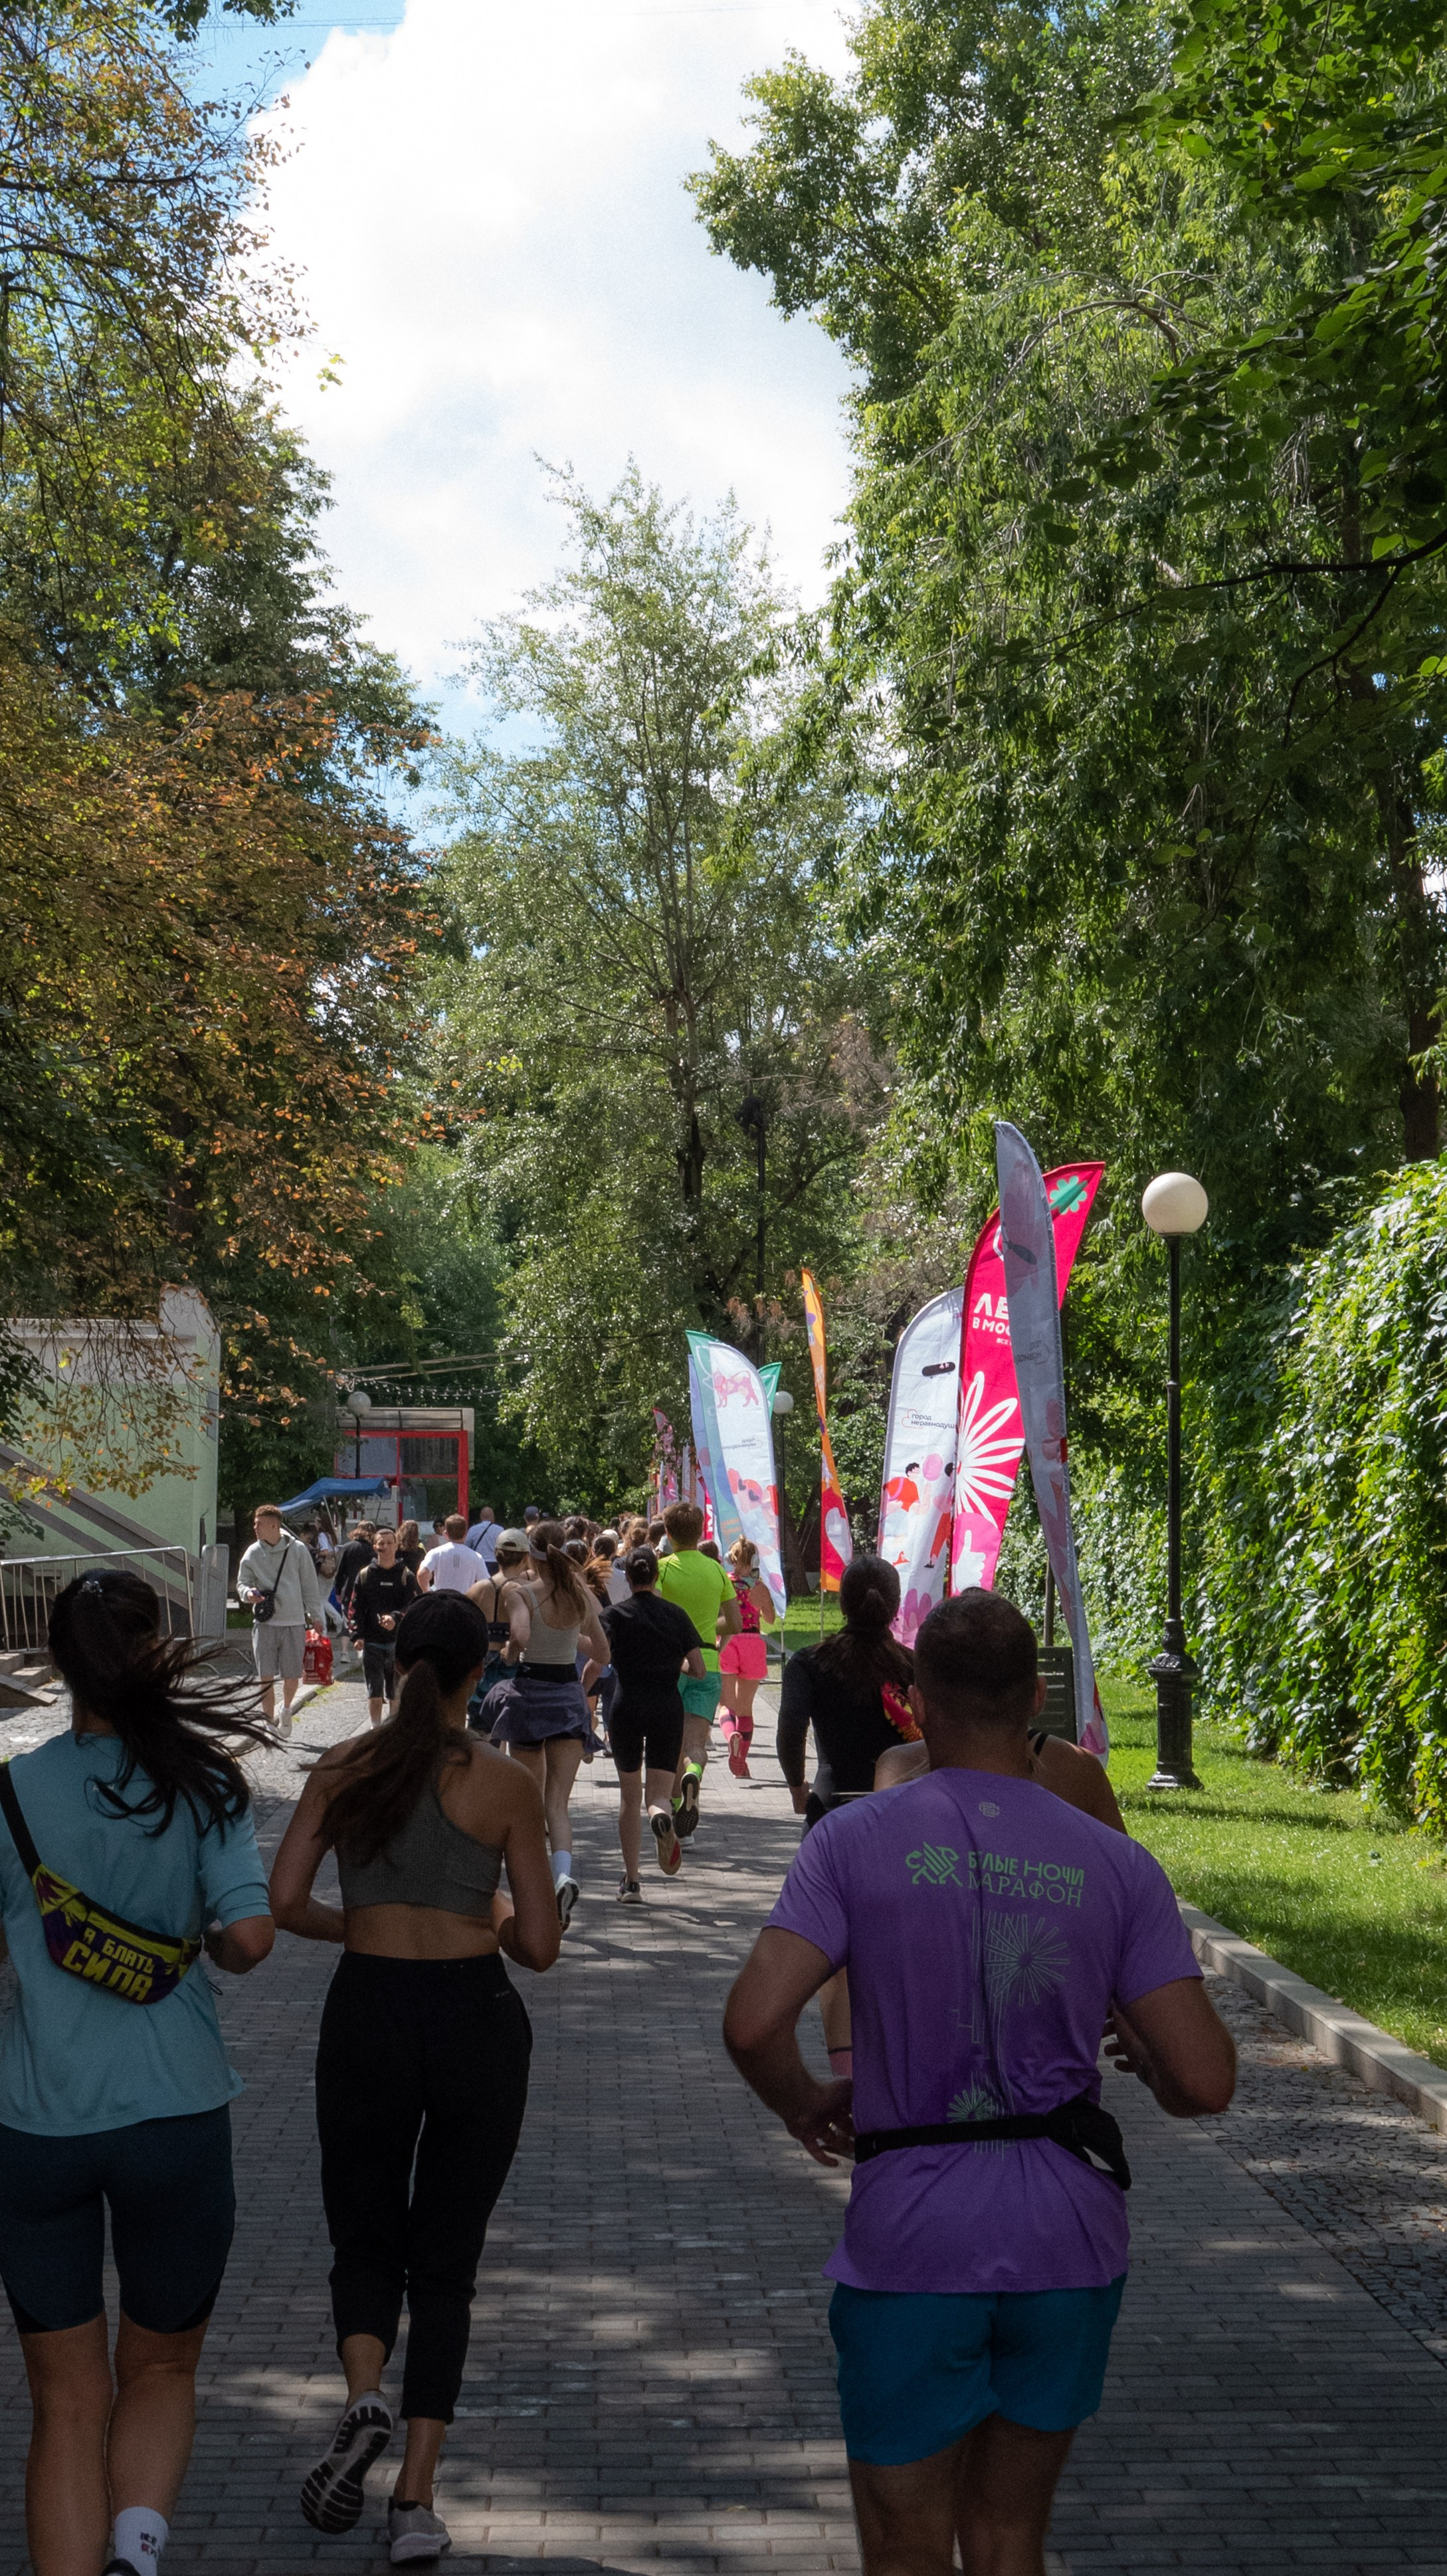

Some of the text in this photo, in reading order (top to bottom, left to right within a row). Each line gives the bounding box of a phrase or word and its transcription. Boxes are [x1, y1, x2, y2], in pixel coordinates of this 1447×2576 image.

[973, 1292, 1009, 1320] ЛЕ
[972, 1316, 980, 1329] В
[1023, 1860, 1085, 1887] НОЧИ
[967, 1870, 1083, 1908] МАРАФОН
[83, 1928, 155, 1975] Я БЛЯТЬ
